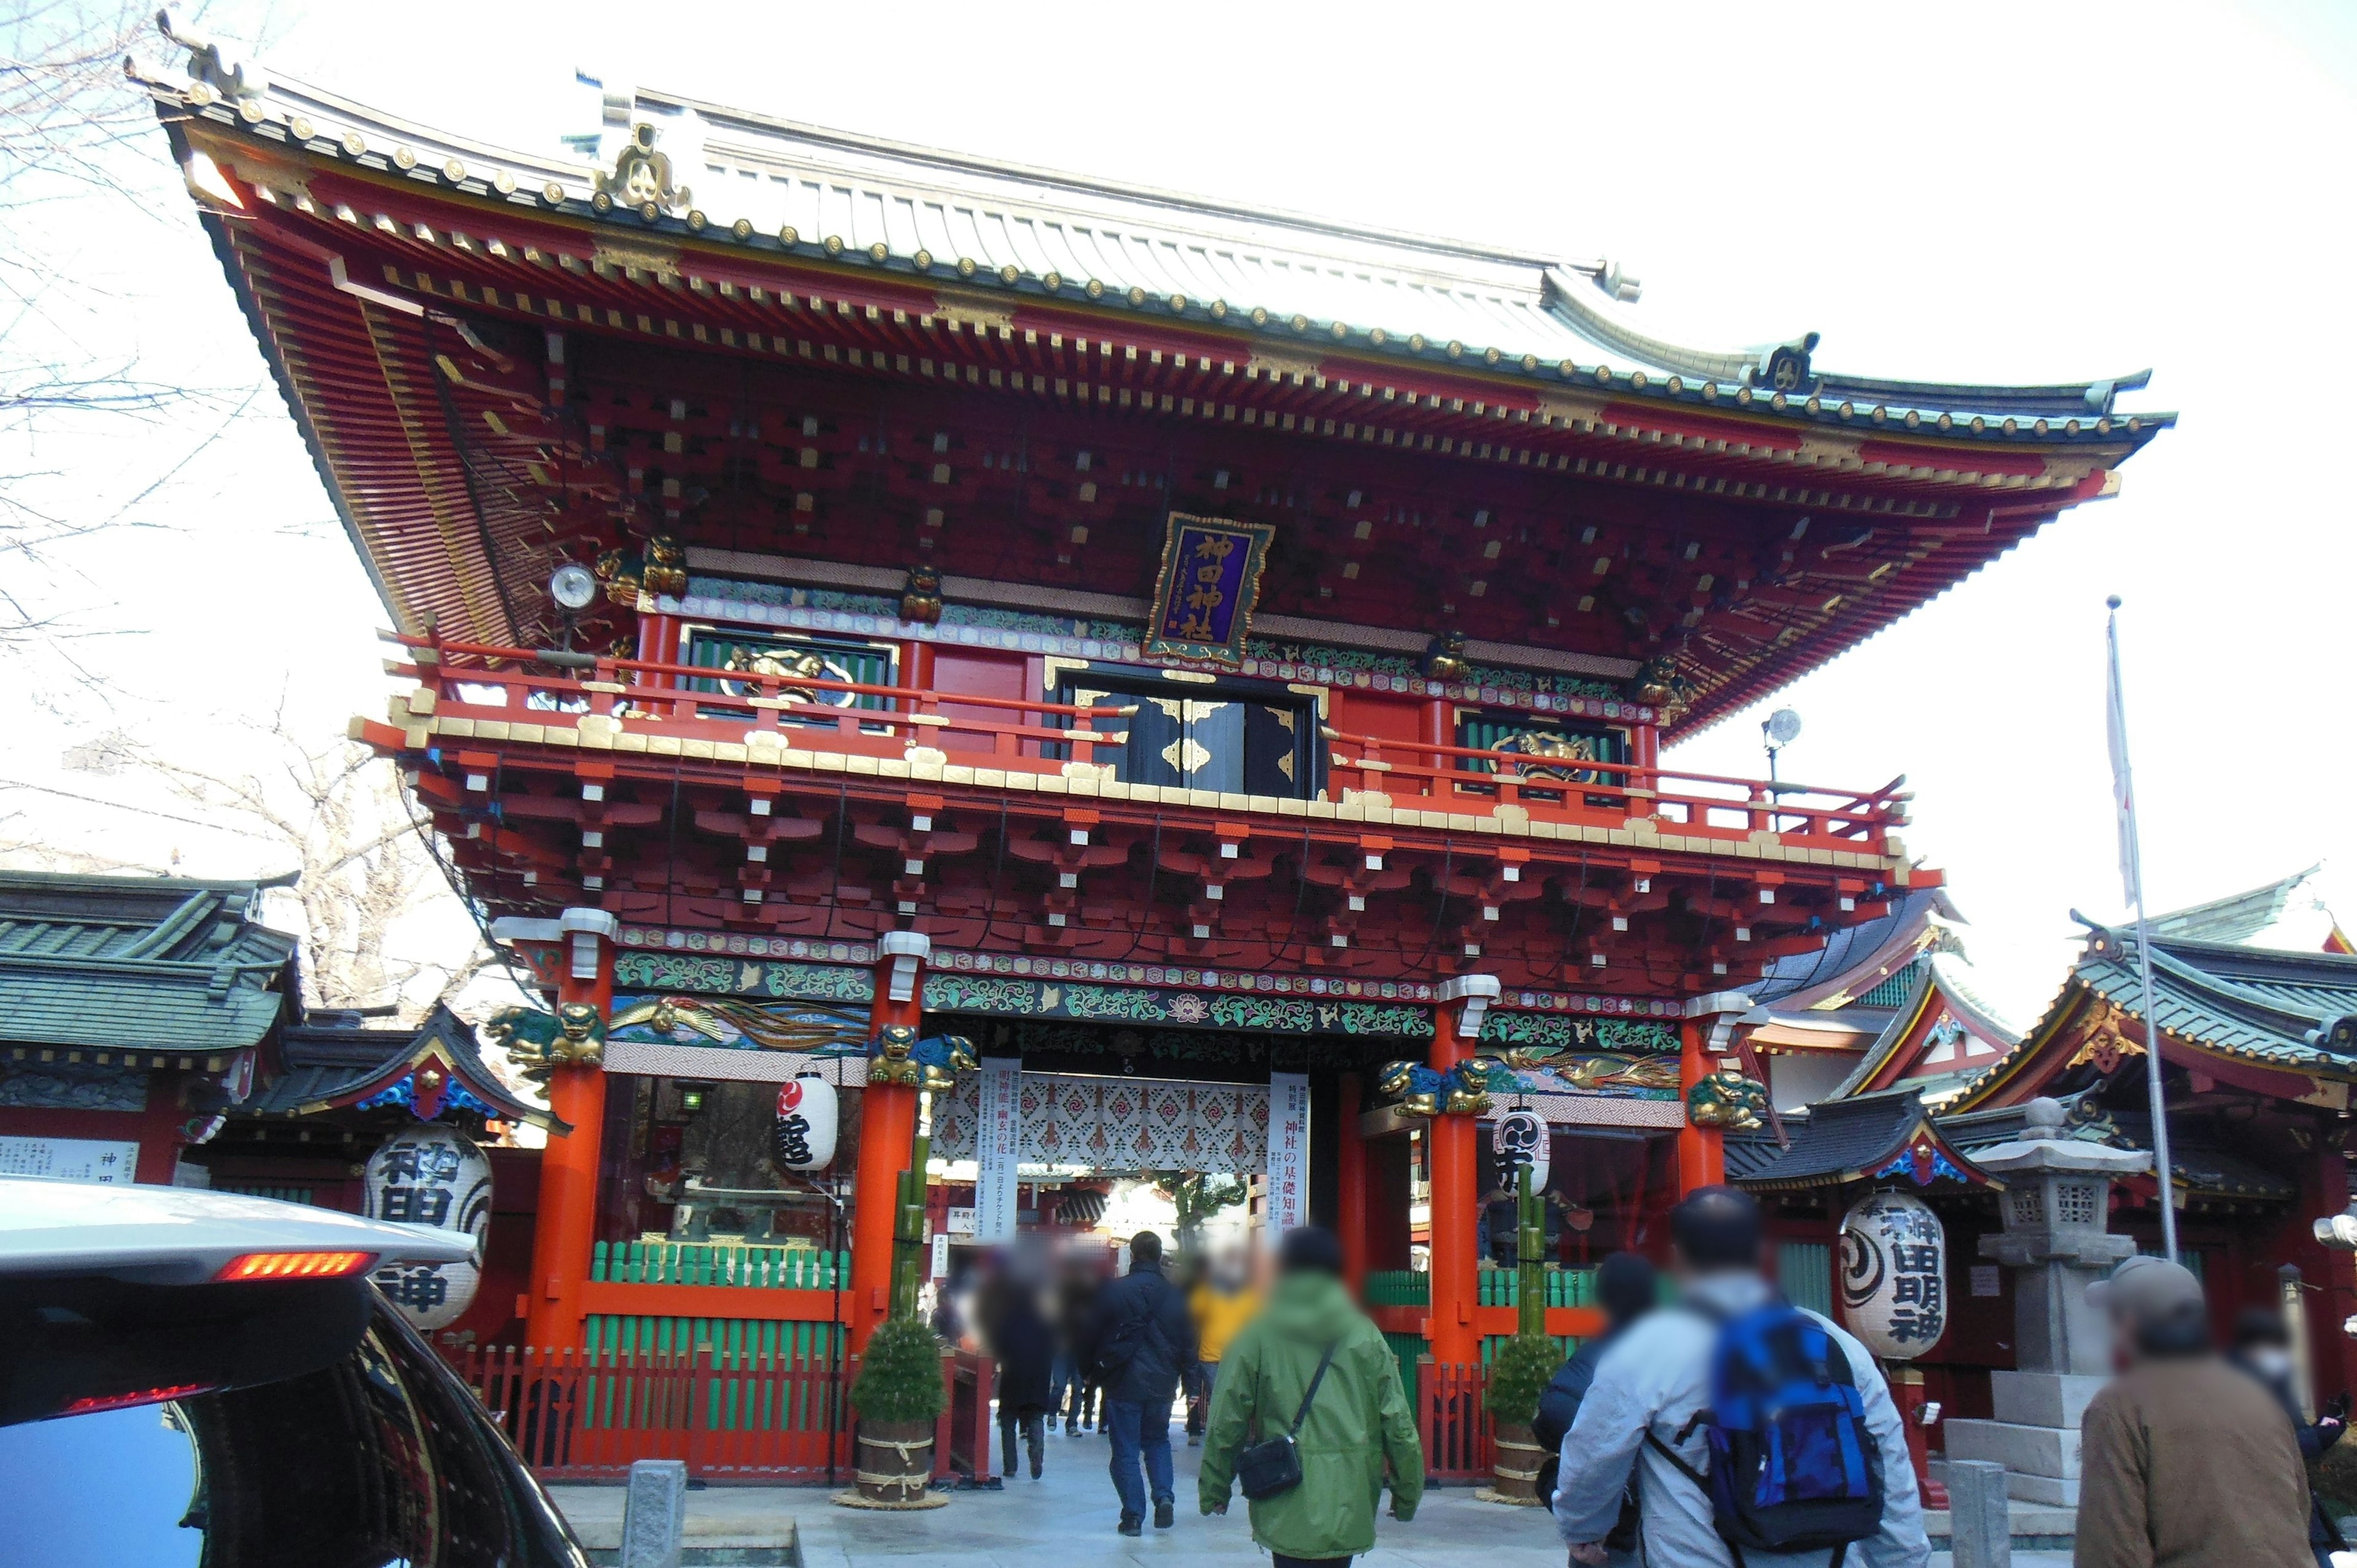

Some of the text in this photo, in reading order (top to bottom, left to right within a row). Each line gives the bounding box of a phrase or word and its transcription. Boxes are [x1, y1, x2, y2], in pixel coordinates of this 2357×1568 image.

[1178, 535, 1234, 641] 神田神社
[1288, 1085, 1296, 1111] 特別展
[374, 1141, 461, 1313] 神田神
[1880, 1207, 1943, 1343] 神田明神
